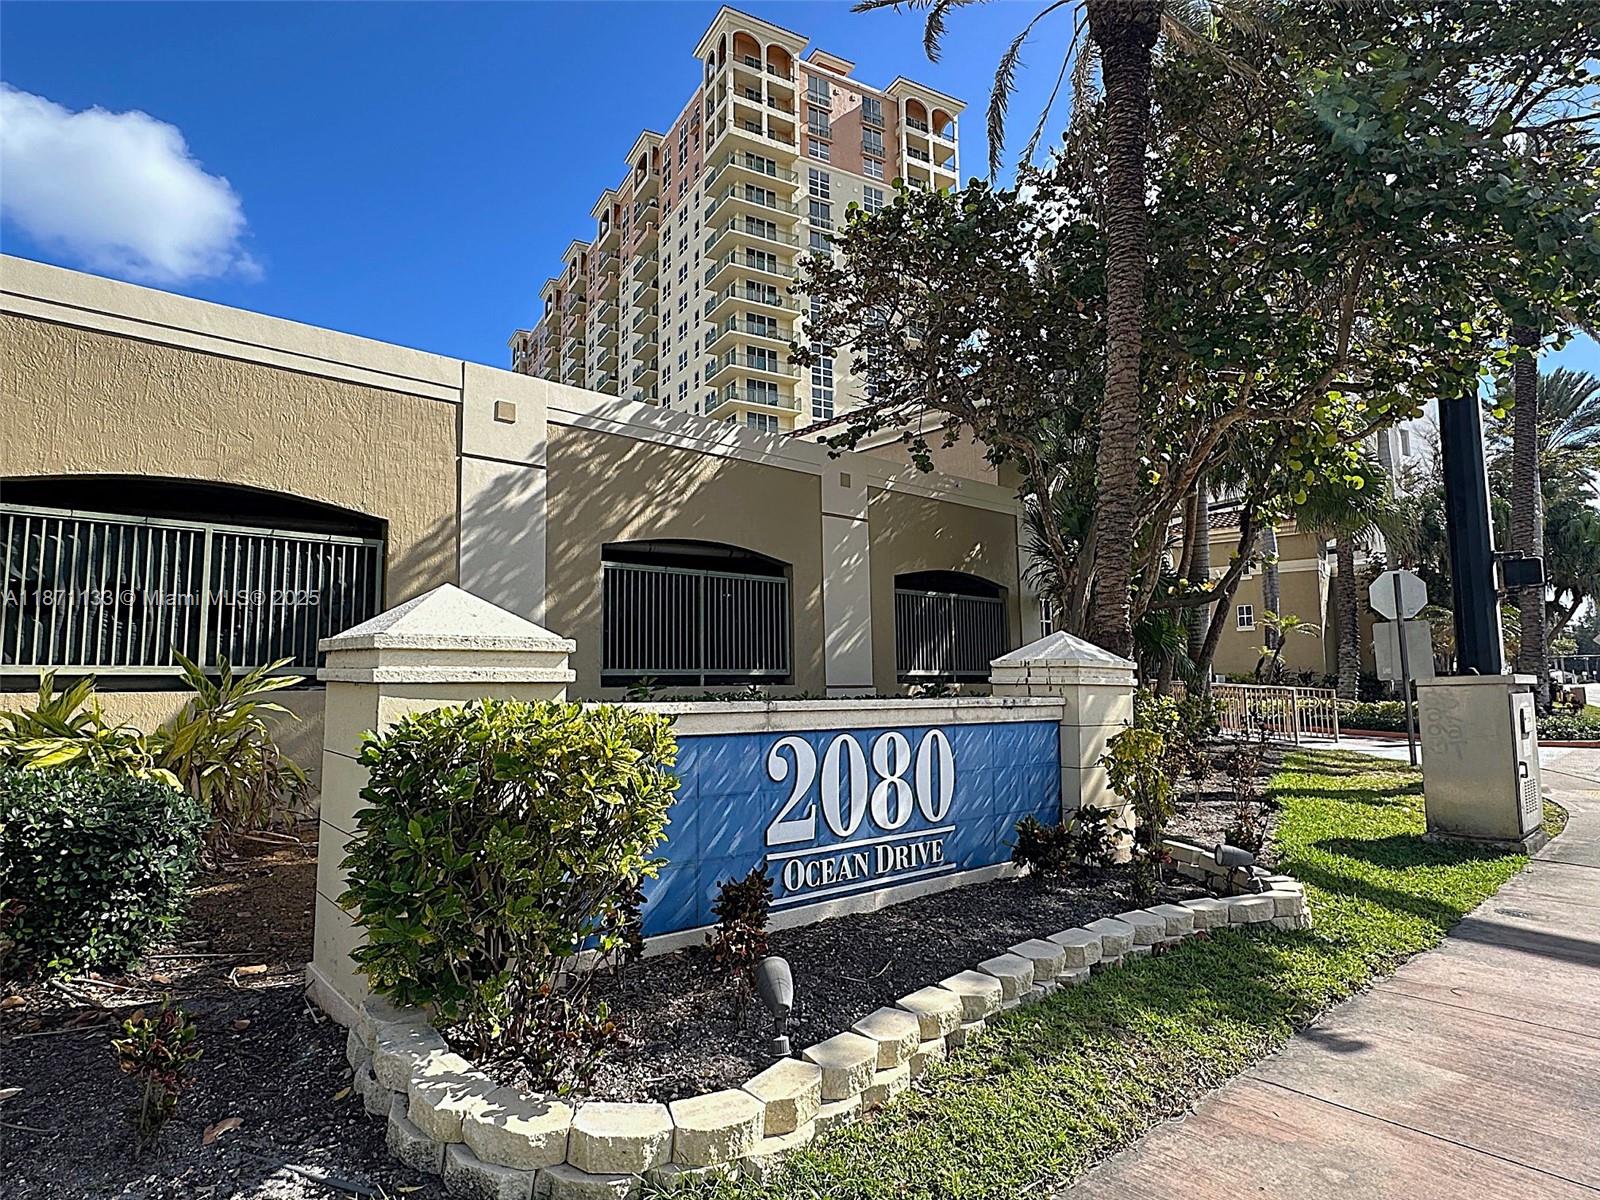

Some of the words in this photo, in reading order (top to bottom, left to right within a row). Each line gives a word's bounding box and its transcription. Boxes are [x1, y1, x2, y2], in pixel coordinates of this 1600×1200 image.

[766, 728, 955, 846] 2080
[783, 852, 870, 891] OCEAN
[875, 839, 944, 875] DRIVE
